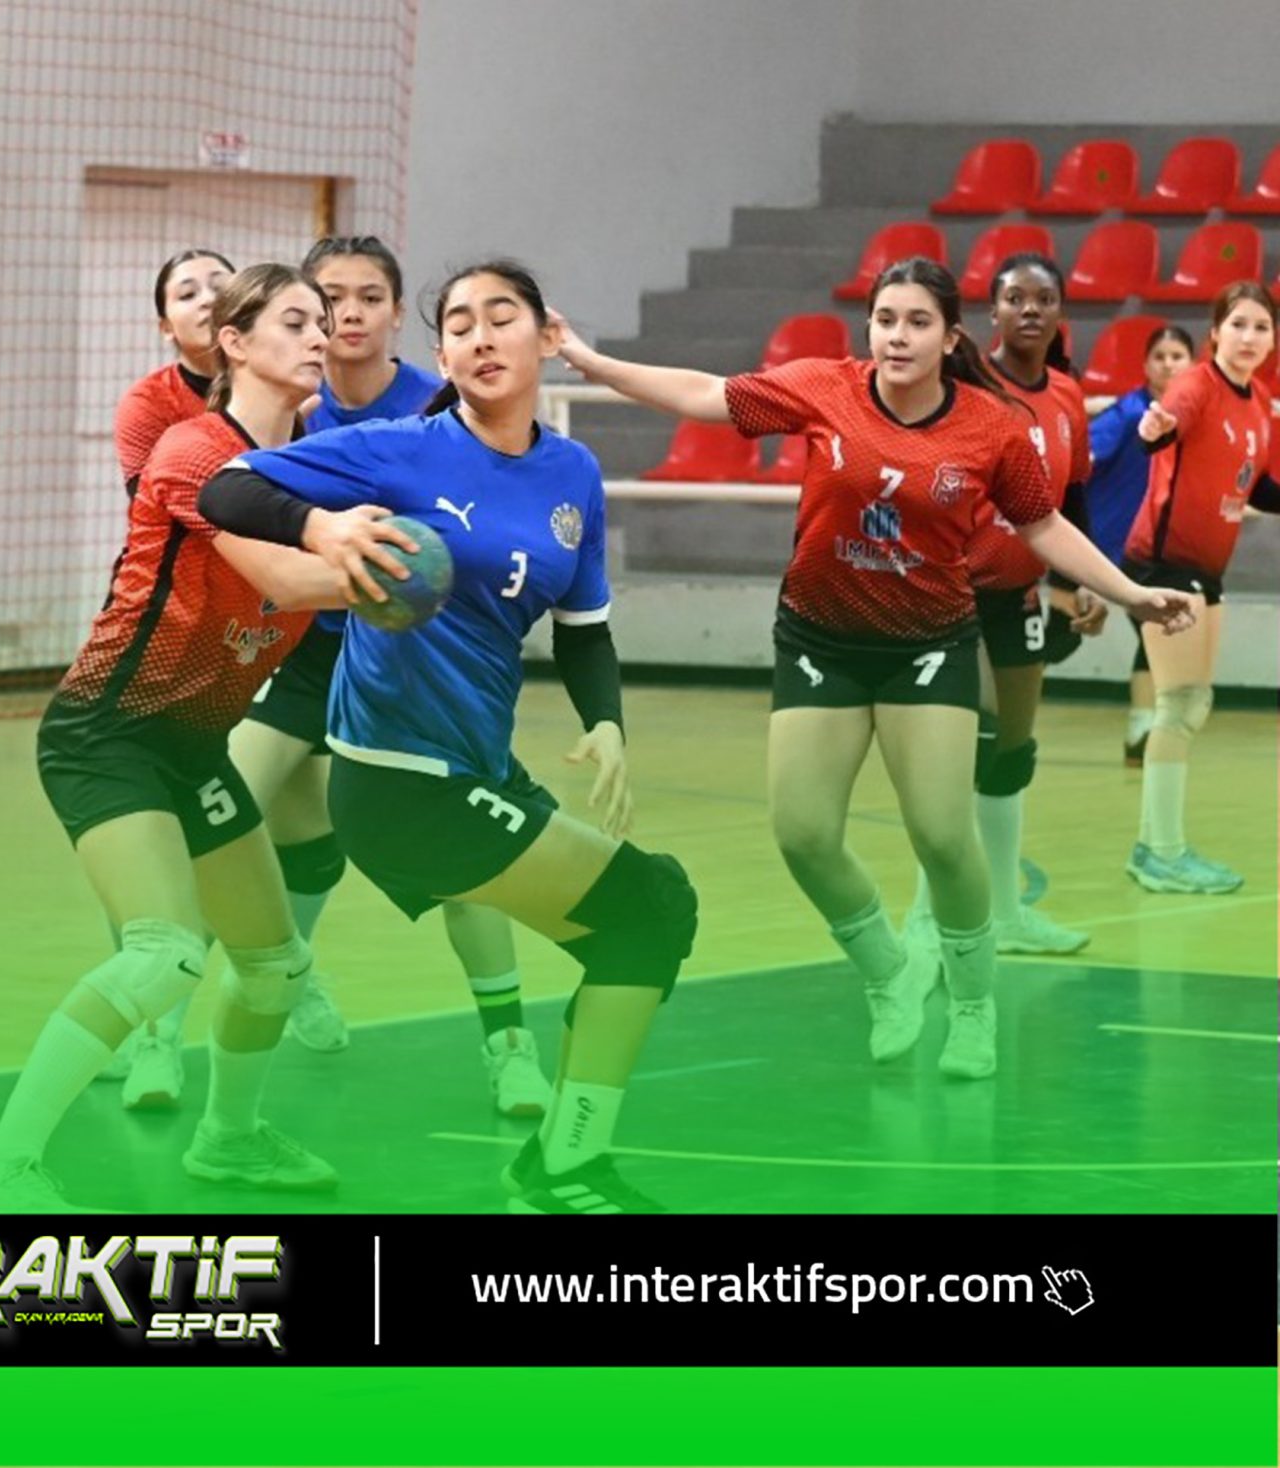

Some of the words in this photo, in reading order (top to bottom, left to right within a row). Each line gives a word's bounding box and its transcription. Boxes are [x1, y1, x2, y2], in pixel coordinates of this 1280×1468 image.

[880, 466, 905, 498] 7
[501, 551, 527, 598] 3
[1024, 615, 1045, 651] 9
[913, 651, 946, 686] 7
[196, 776, 238, 827] 5
[467, 786, 527, 834] 3
